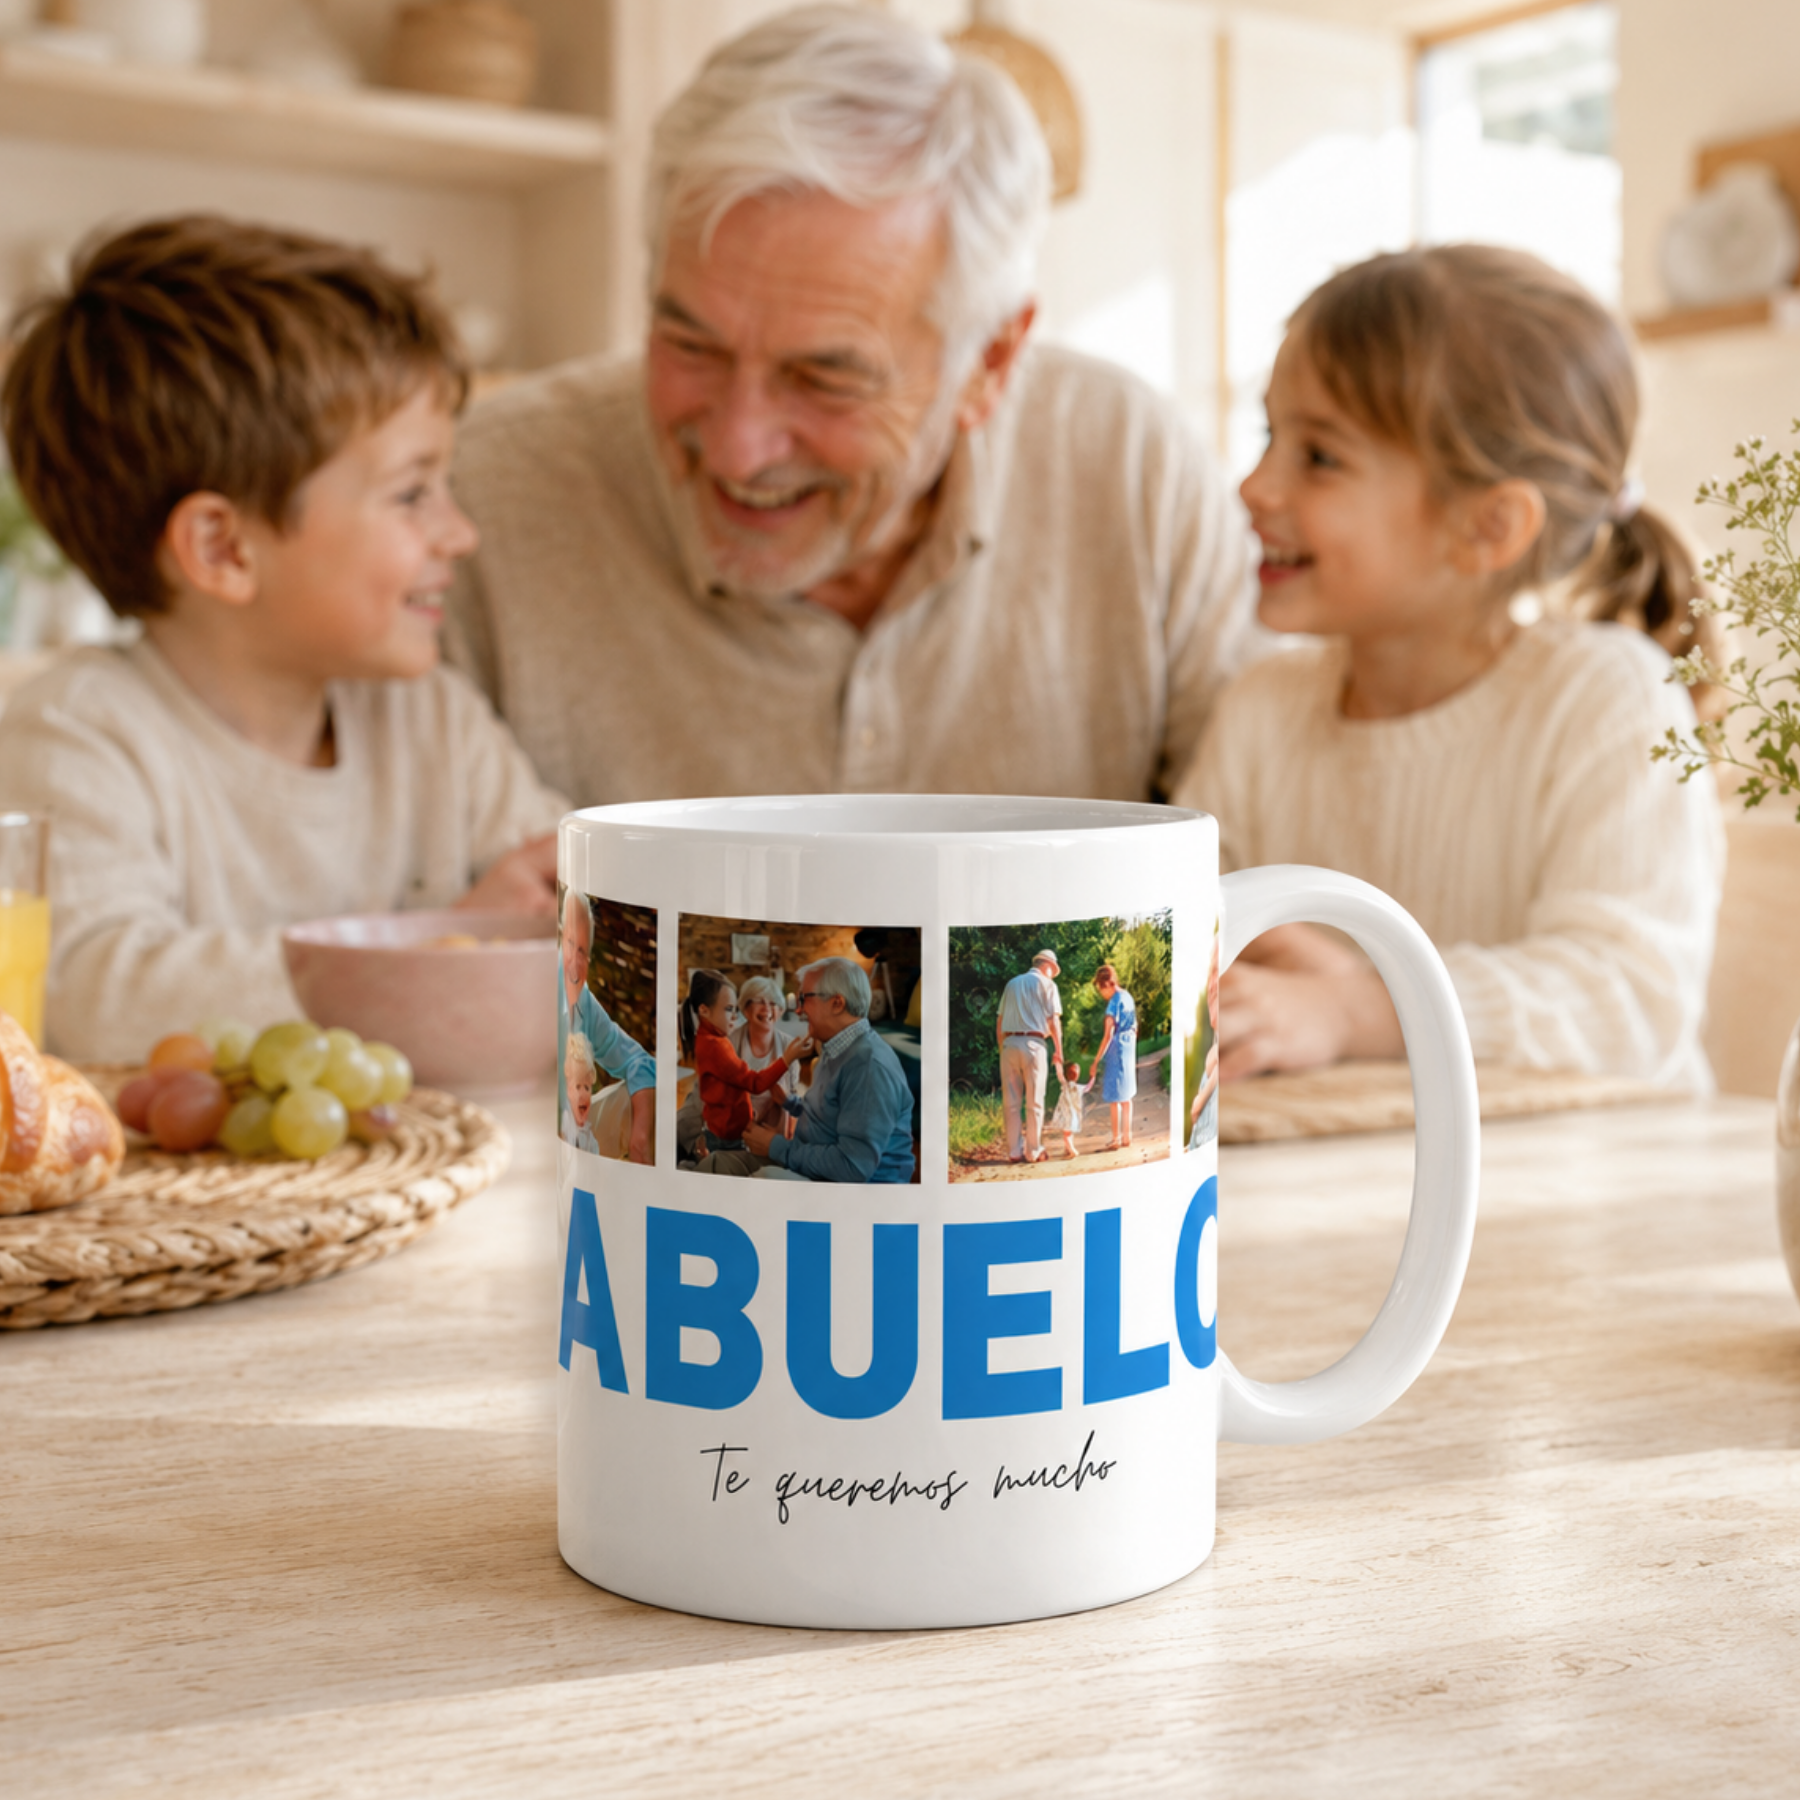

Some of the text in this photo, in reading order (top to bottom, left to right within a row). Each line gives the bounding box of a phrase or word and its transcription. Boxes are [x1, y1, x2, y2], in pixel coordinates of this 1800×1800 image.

[559, 1175, 1218, 1420] ABUELO
[699, 1430, 1117, 1525] Te queremos mucho
